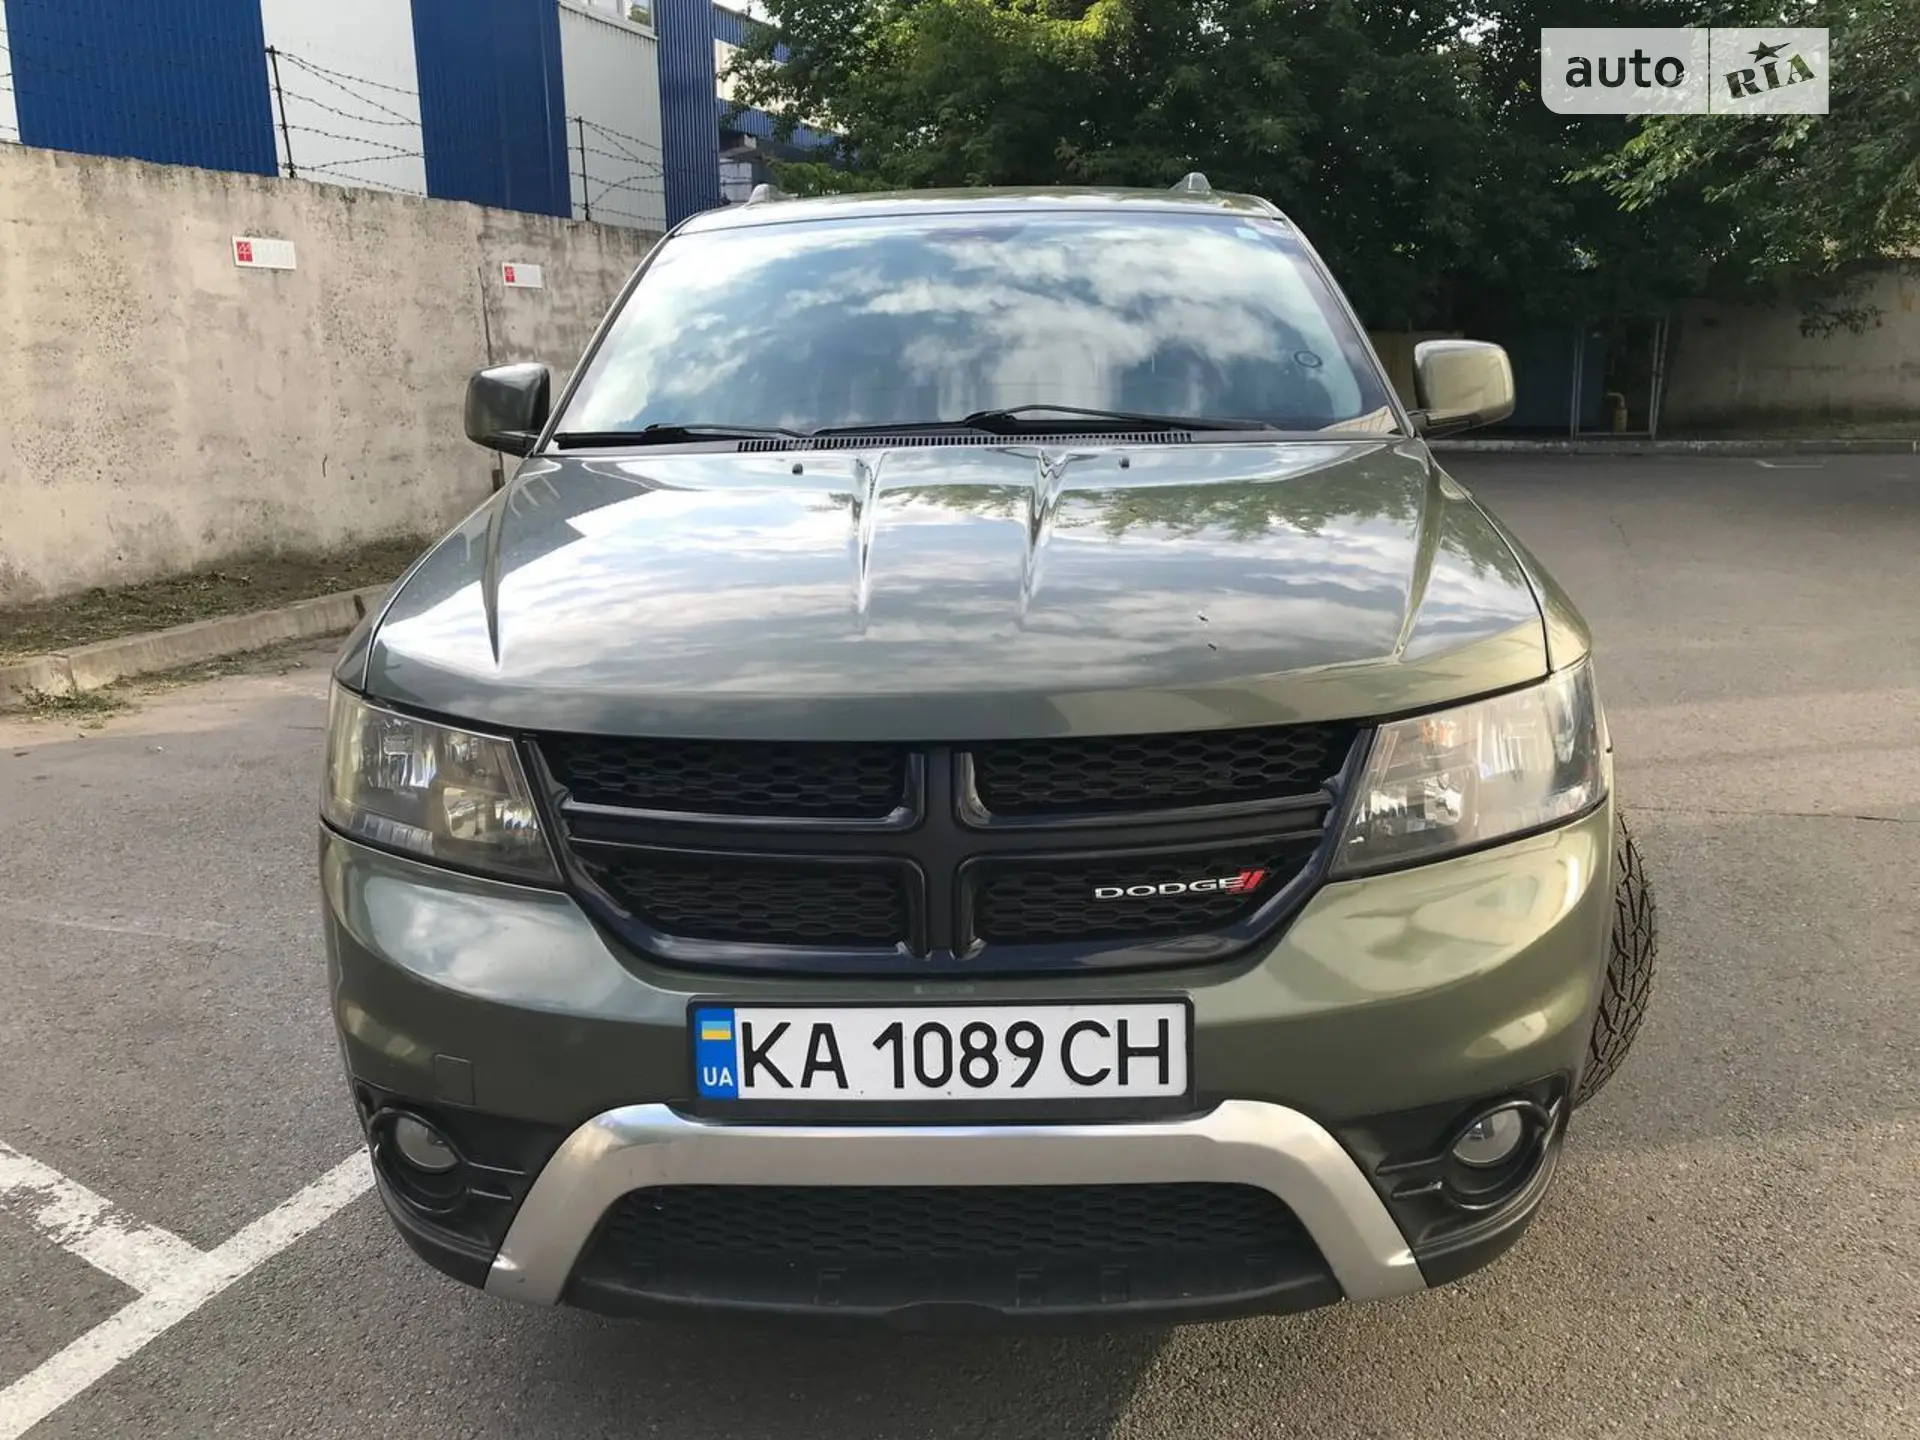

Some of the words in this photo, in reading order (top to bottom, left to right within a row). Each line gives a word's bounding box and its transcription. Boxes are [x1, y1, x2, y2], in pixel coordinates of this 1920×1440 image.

[1095, 877, 1244, 899] DODGE
[742, 1022, 849, 1089] KA
[872, 1021, 1045, 1089] 1089
[1061, 1018, 1170, 1086] CH
[703, 1067, 733, 1087] UA
